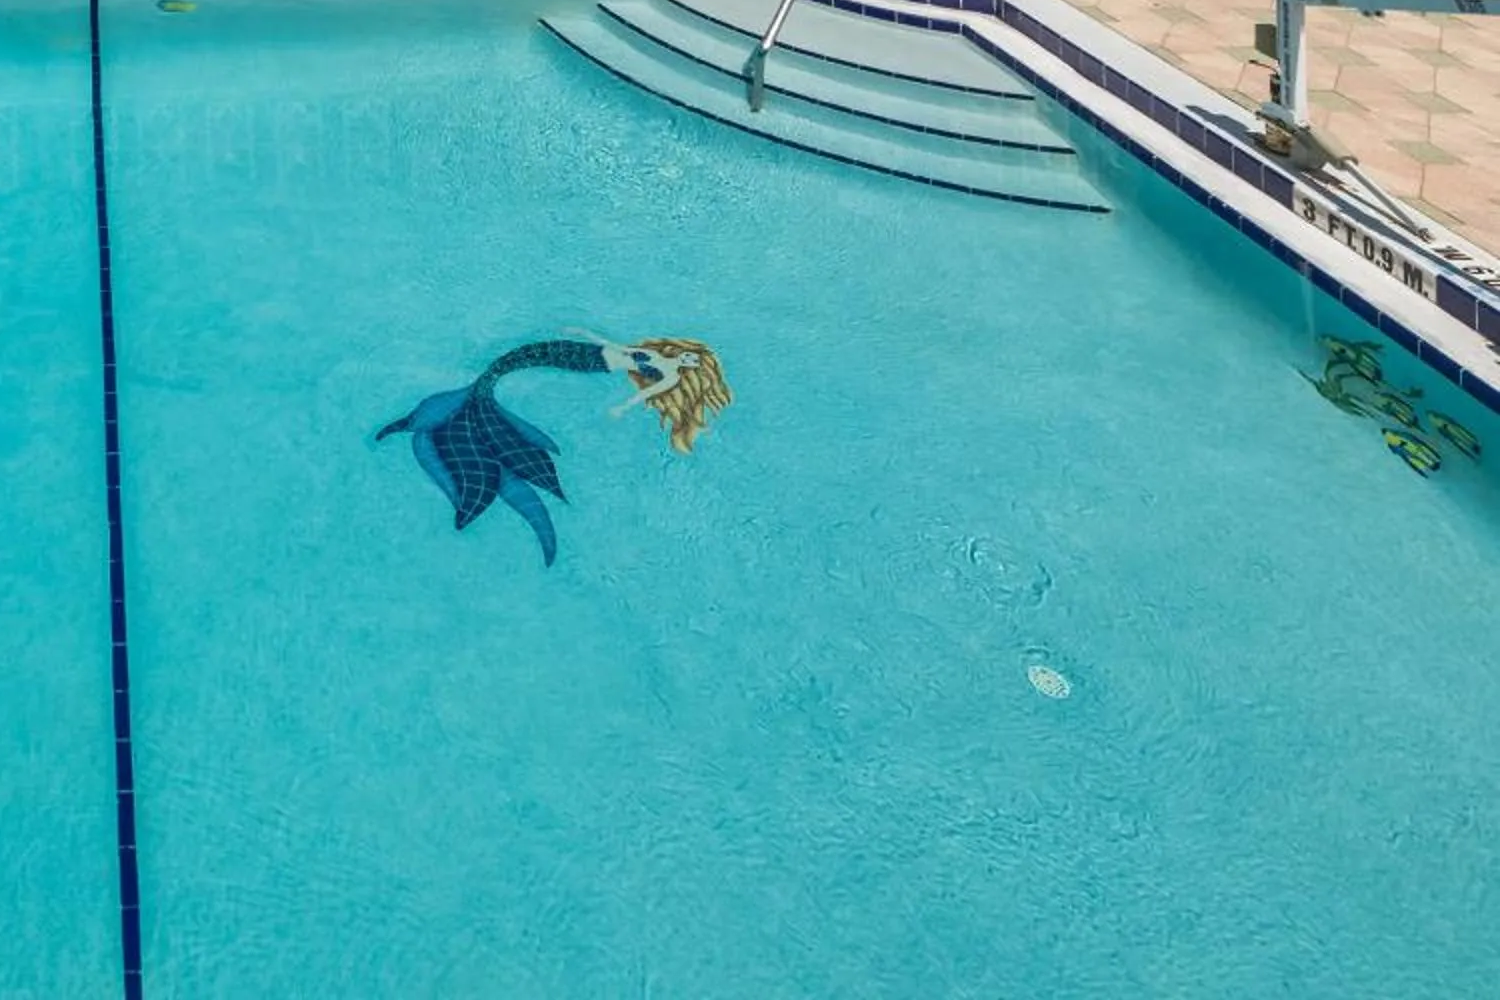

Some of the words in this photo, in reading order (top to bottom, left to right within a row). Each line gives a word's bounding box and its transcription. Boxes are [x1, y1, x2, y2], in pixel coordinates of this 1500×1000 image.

[1302, 198, 1316, 222] 3
[1363, 234, 1393, 273] 0.9
[1403, 260, 1429, 298] M.
